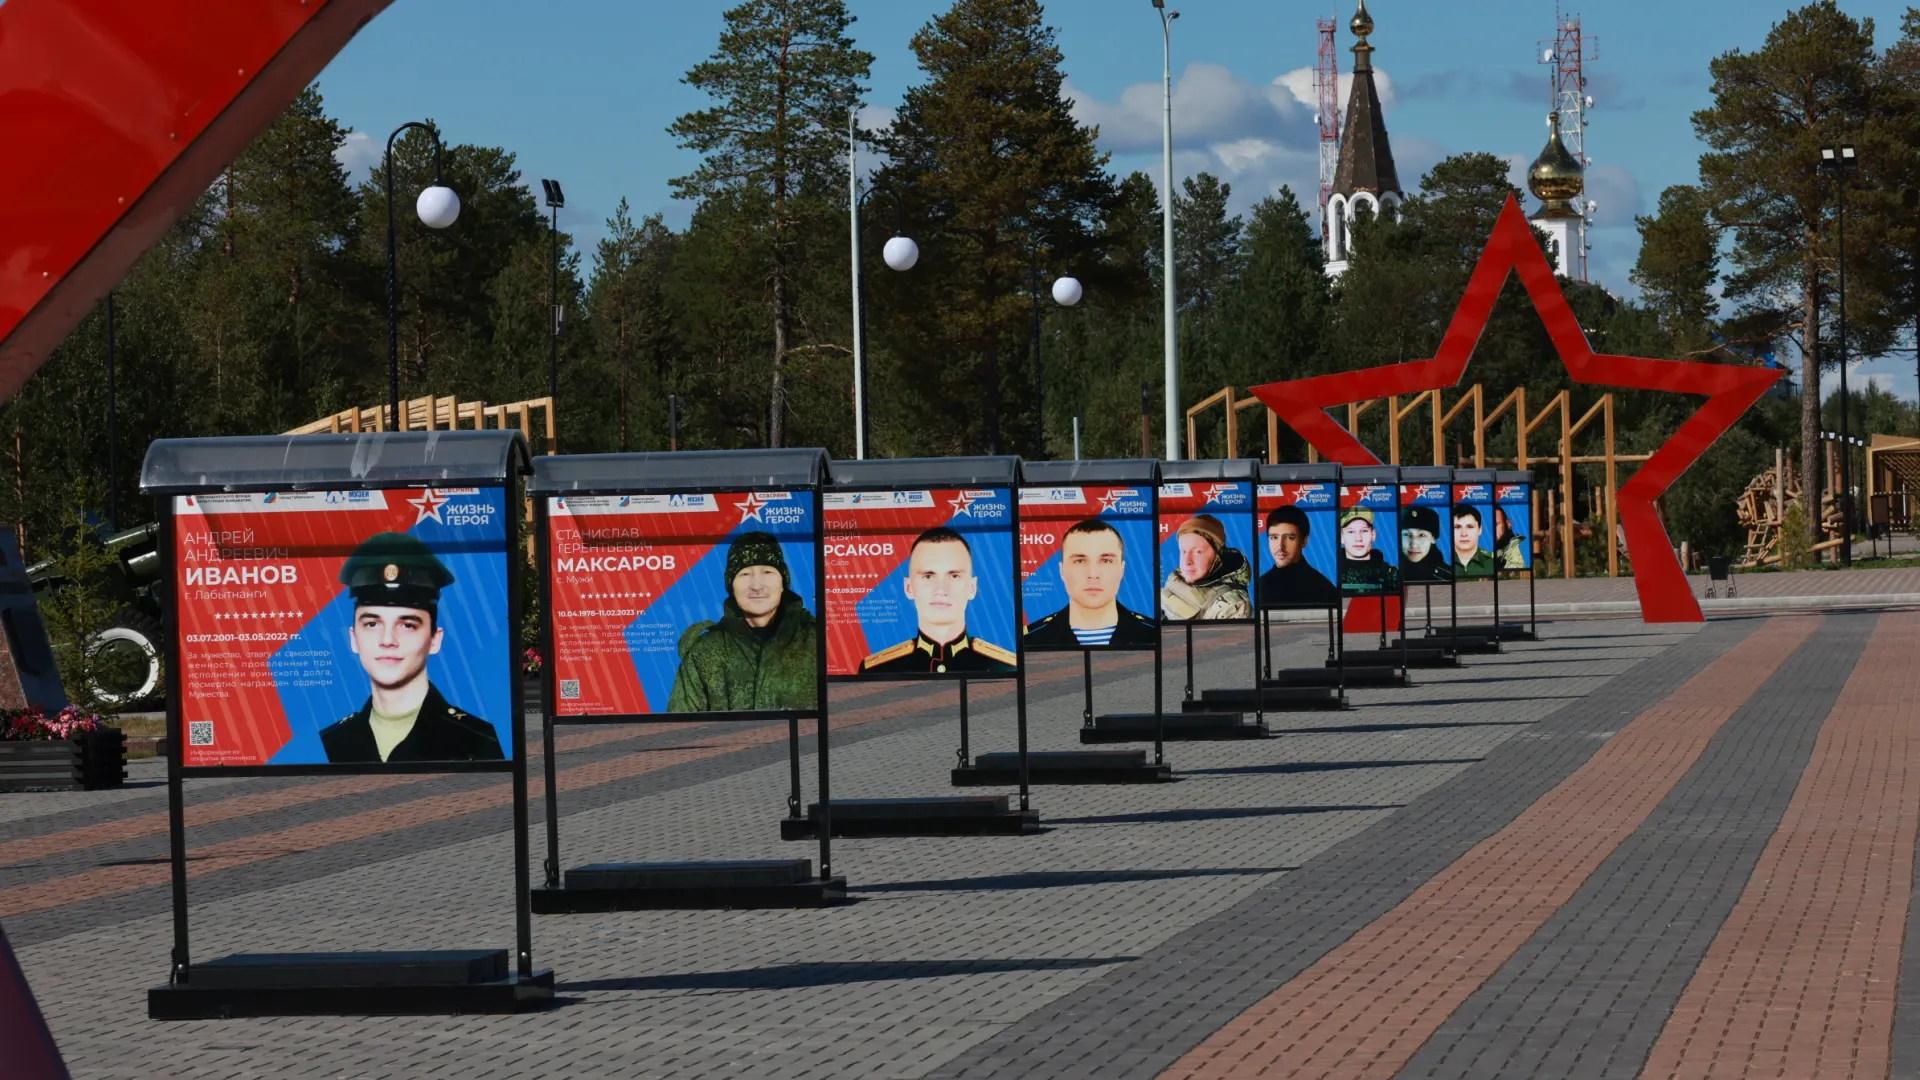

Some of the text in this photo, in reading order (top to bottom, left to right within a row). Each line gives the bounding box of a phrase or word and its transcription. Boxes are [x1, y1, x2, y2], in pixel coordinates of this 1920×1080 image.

[446, 504, 495, 514] ЖИЗНЬ
[765, 506, 804, 516] ЖИЗНЬ
[446, 514, 489, 526] ГЕРОЯ
[766, 516, 800, 524] ГЕРОЯ
[824, 519, 858, 530] ТРИЙ
[184, 528, 254, 546] АНДРЕЙ
[556, 528, 640, 540] СТАНИСЛАВ
[184, 547, 289, 564] АНДРЕЕВИЧ
[557, 555, 676, 572] МАКСАРОВ
[186, 566, 298, 586] ИВАНОВ
[566, 576, 594, 585] Мужи
[194, 590, 267, 600] Лабытнанги
[201, 652, 242, 660] мужество,
[245, 651, 272, 660] отвагу
[241, 660, 308, 668] проявленные
[240, 680, 288, 688] награжден
